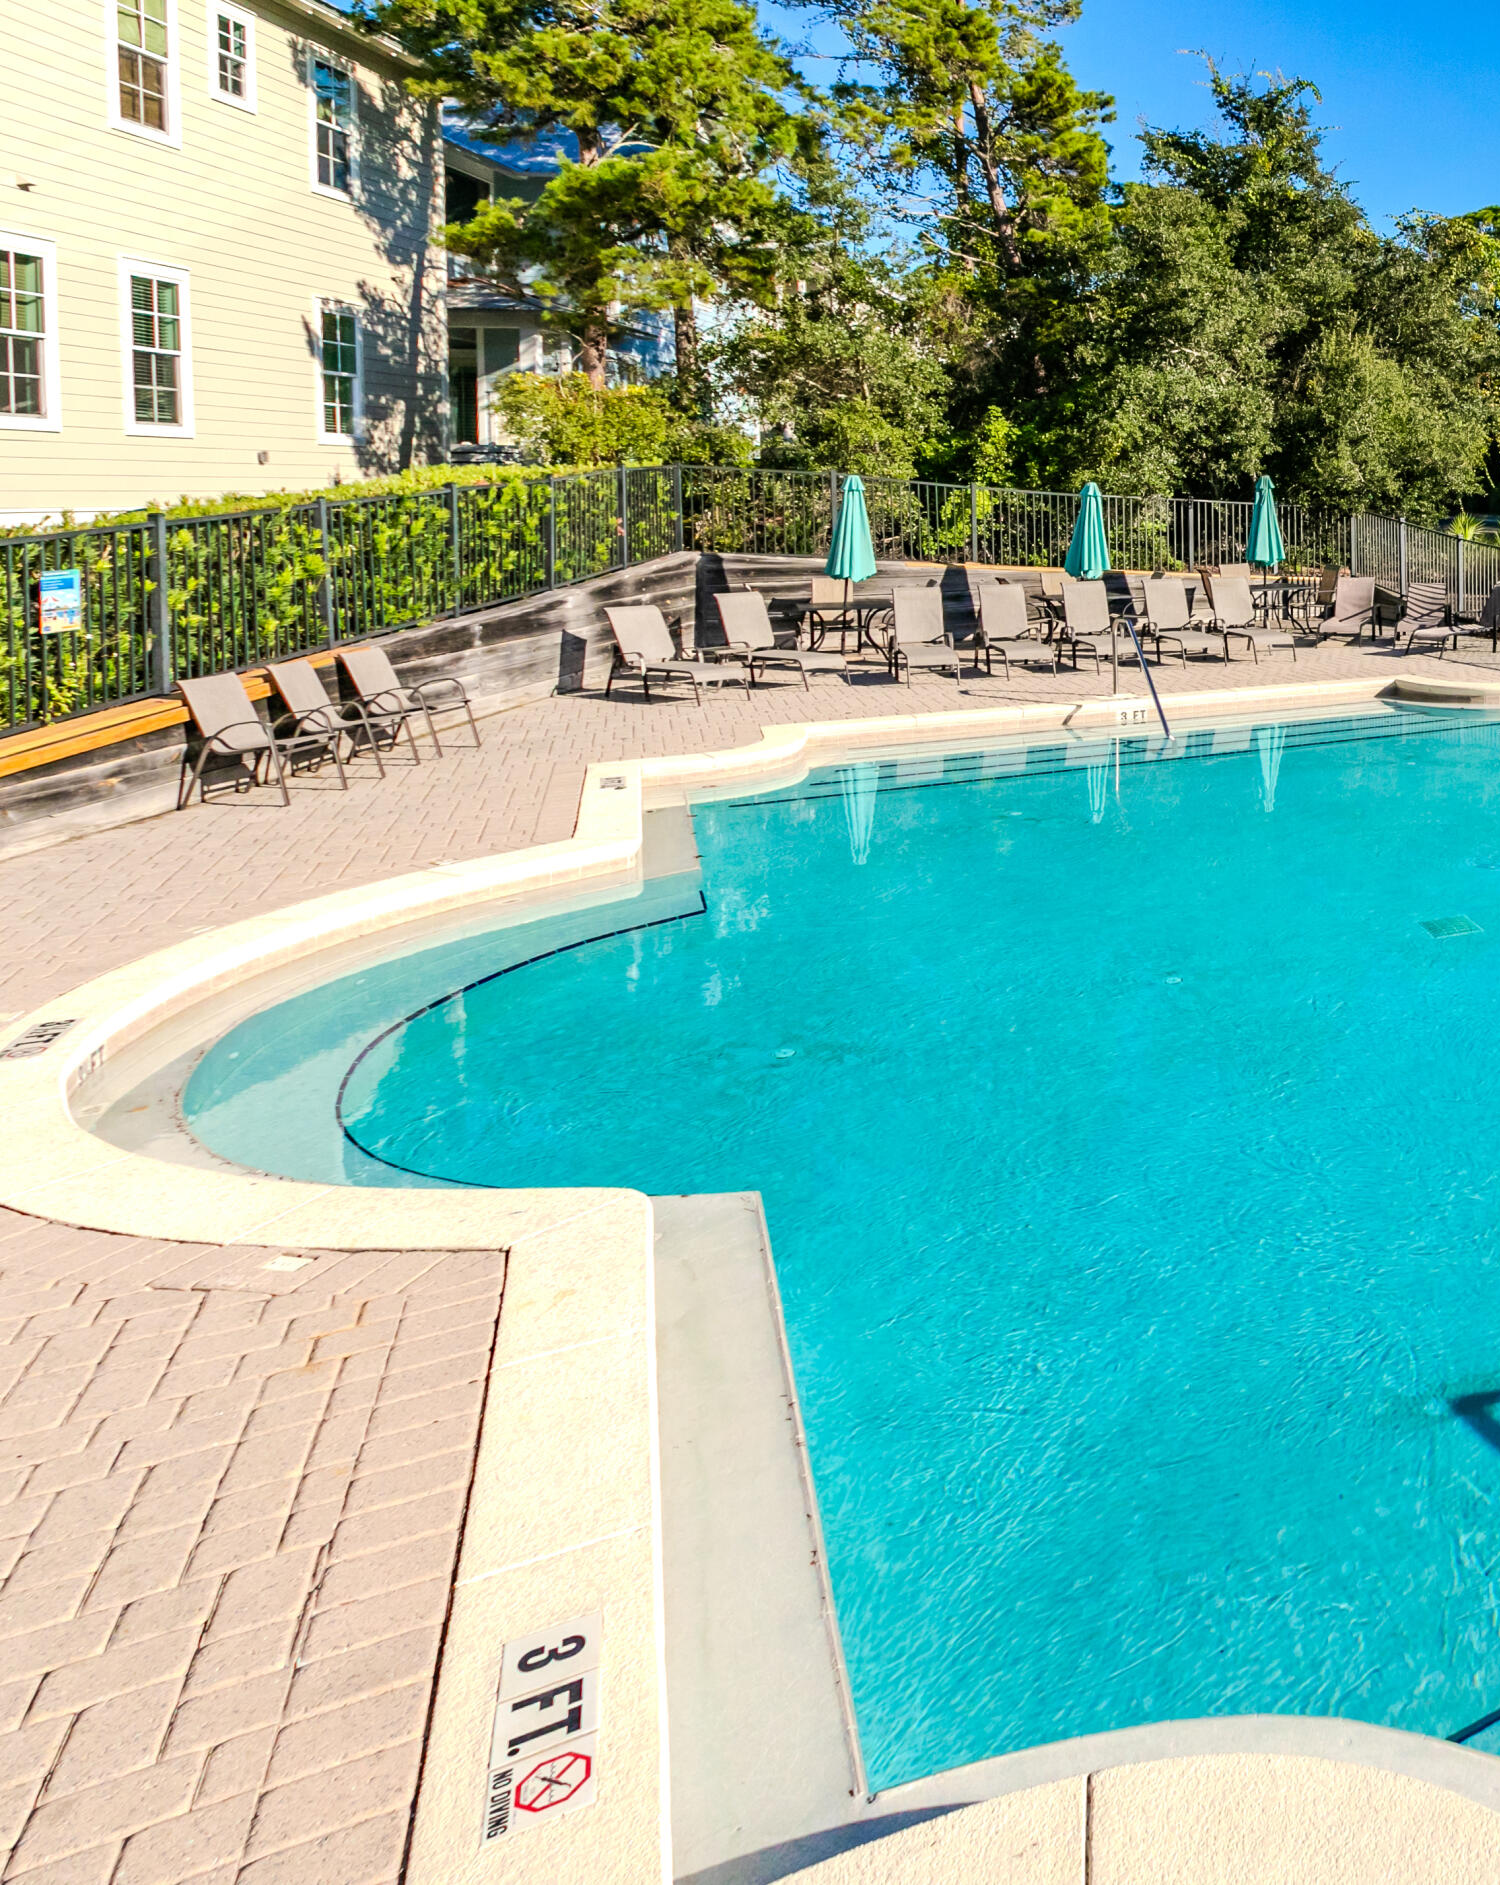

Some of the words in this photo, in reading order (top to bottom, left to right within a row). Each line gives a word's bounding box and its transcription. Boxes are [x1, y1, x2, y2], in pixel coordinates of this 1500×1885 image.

[1121, 711, 1127, 720] 3
[1133, 709, 1146, 719] FT
[517, 1634, 586, 1673] 3
[507, 1677, 584, 1757] FT.
[492, 1768, 513, 1790] NO
[487, 1790, 511, 1839] DIVING
